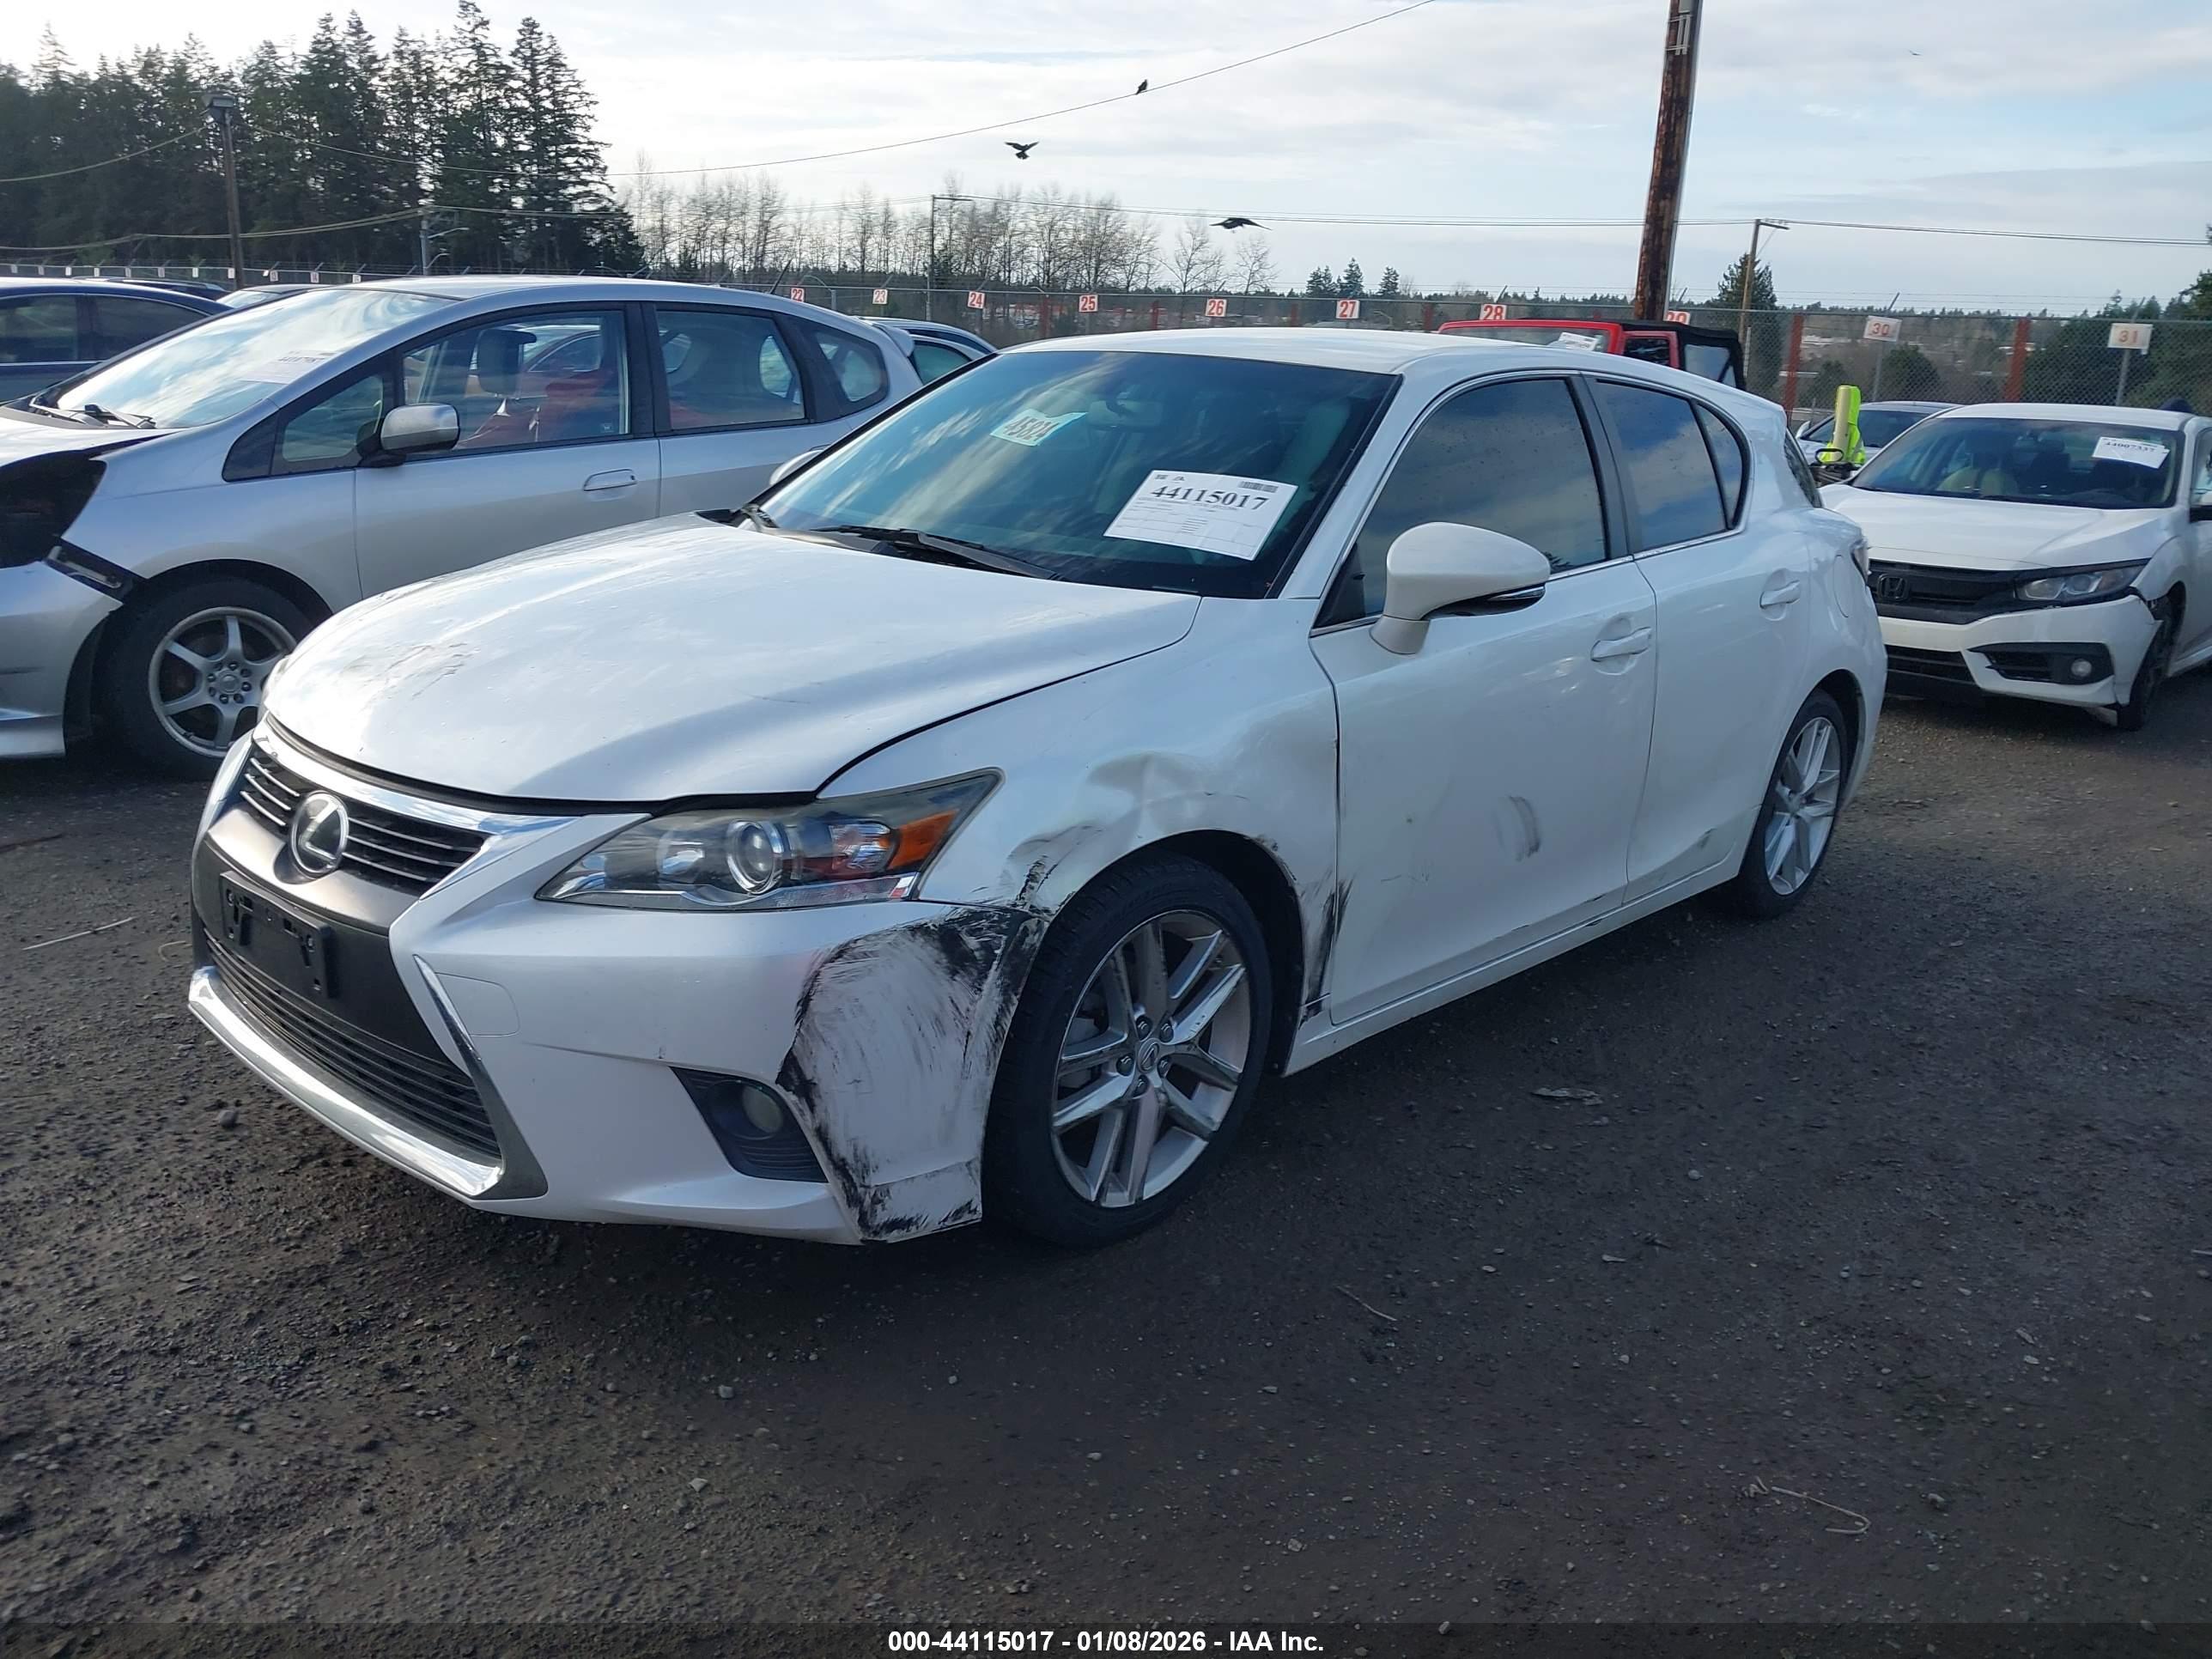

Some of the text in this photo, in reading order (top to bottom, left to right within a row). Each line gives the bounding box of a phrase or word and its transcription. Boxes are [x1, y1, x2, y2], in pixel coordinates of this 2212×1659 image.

[791, 289, 804, 302] 22
[874, 290, 887, 302] 23
[969, 292, 983, 307] 24
[1080, 295, 1097, 312] 25
[1209, 300, 1224, 317] 26
[1340, 301, 1356, 319] 27
[1483, 305, 1504, 320] 28
[1871, 322, 1890, 336] 30
[2118, 329, 2138, 343] 31
[1151, 485, 1269, 510] 44115017
